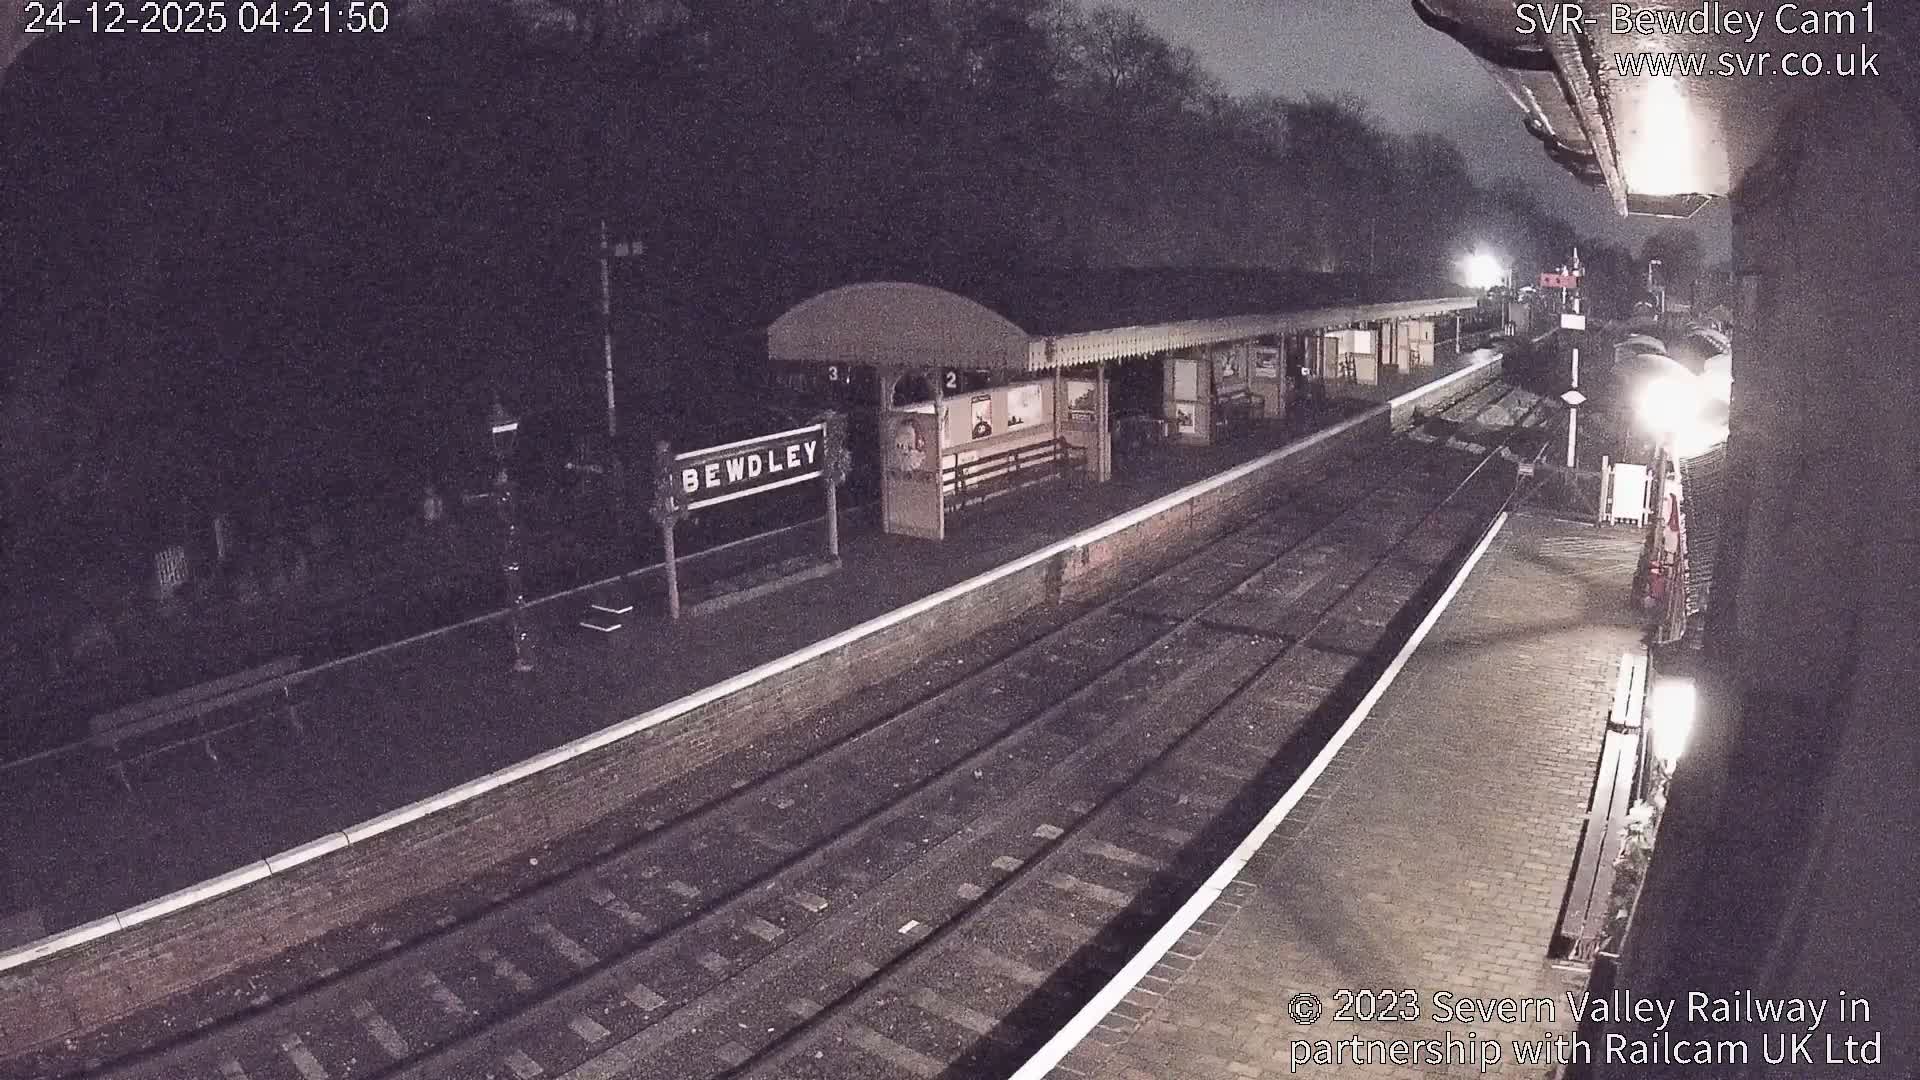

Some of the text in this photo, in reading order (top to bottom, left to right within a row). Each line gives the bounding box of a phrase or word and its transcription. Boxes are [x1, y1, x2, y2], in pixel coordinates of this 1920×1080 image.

[828, 366, 838, 380] 3
[946, 371, 957, 388] 2
[682, 440, 817, 493] BEWDLEY
